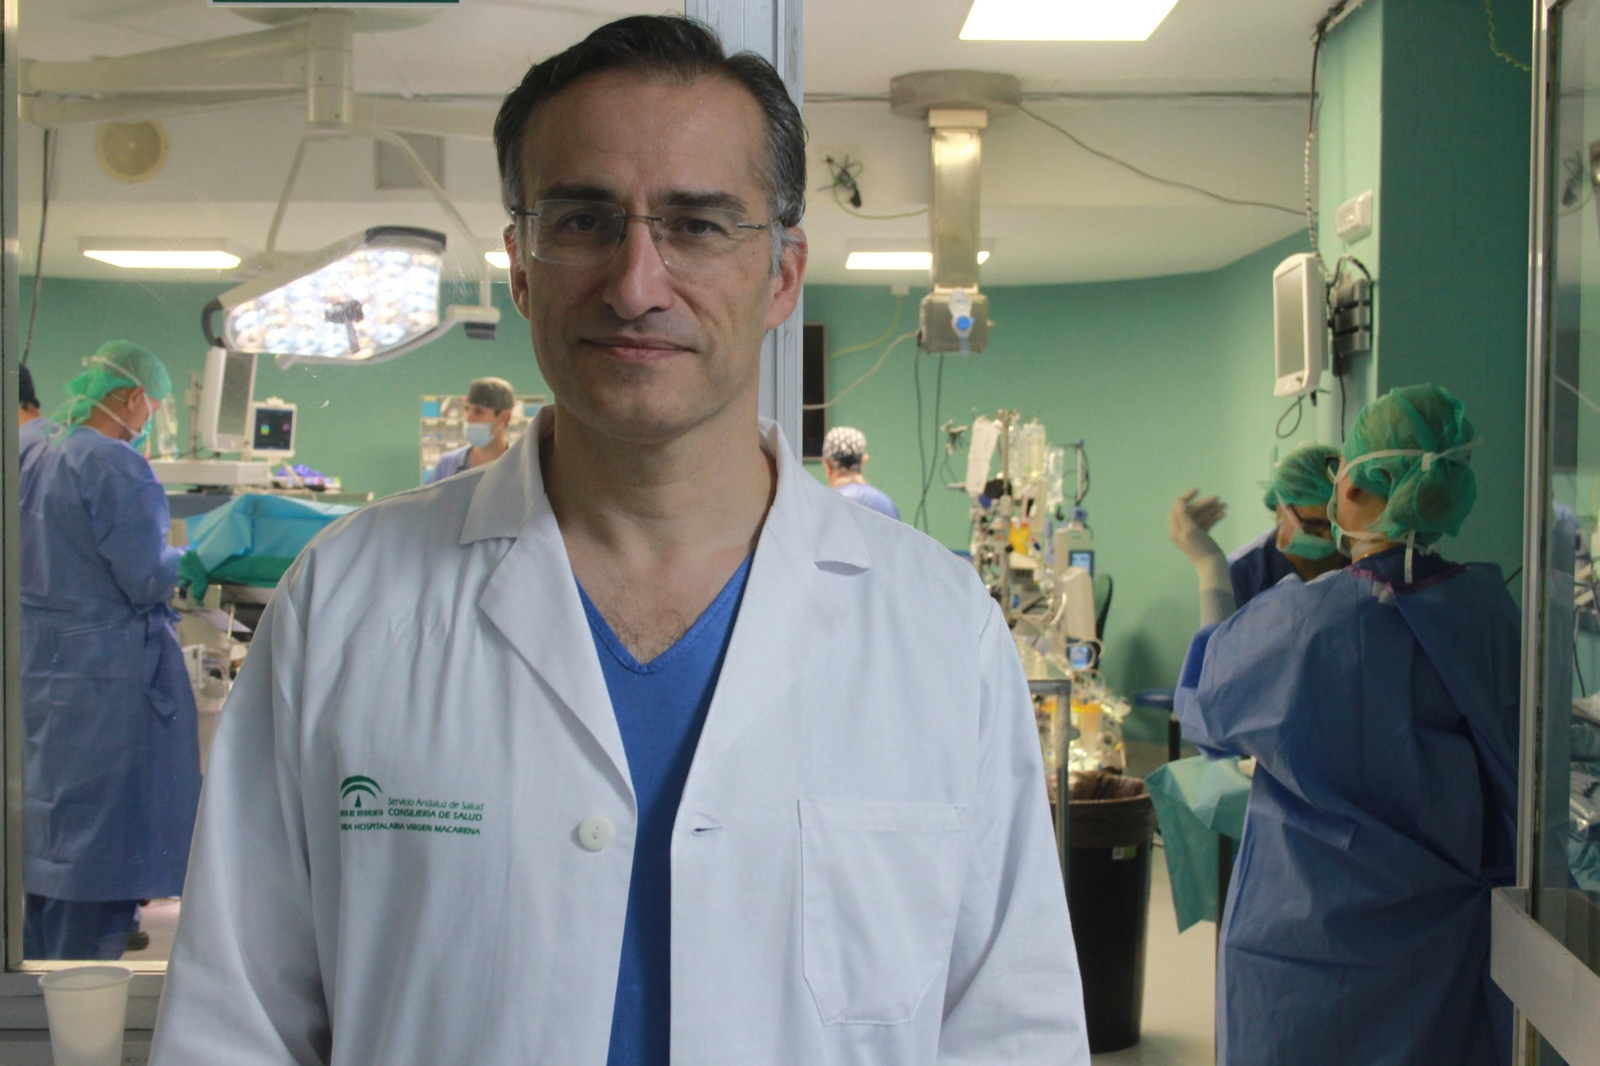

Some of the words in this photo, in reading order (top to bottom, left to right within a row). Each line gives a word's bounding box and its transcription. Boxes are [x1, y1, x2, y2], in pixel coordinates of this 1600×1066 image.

[387, 797, 415, 807] Servicio
[415, 798, 447, 808] Andaluz
[449, 801, 459, 809] de
[462, 801, 484, 811] Salud
[387, 808, 436, 818] CONSEJERÍA
[438, 810, 451, 819] DE
[453, 812, 483, 822] SALUD
[354, 822, 405, 831] HOSPITALARIA
[406, 823, 432, 832] VIRGEN
[434, 825, 481, 835] MACARENA
